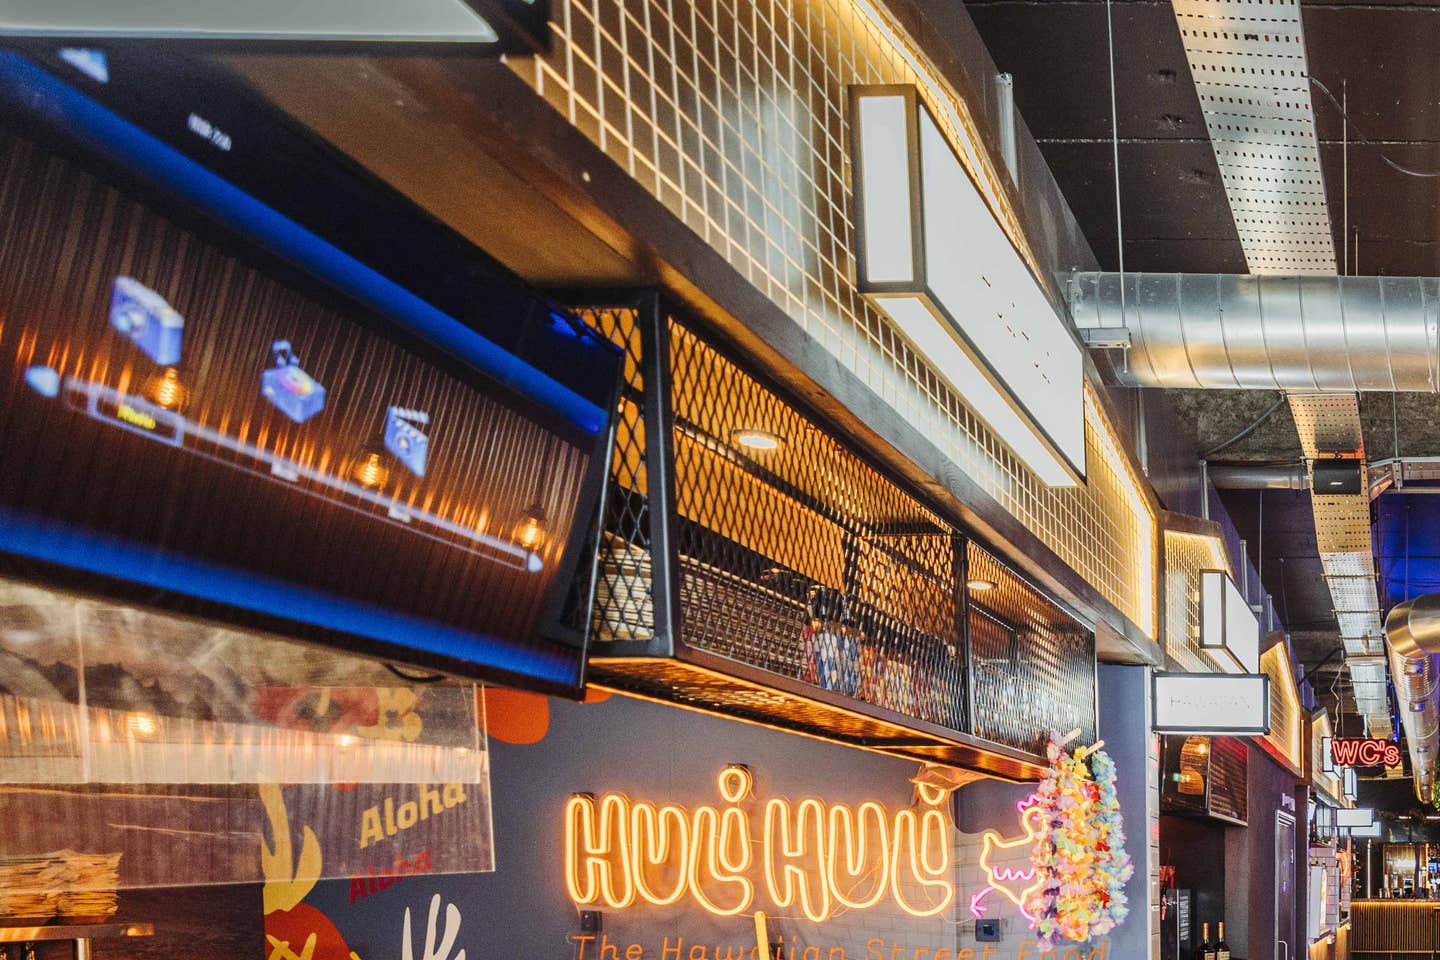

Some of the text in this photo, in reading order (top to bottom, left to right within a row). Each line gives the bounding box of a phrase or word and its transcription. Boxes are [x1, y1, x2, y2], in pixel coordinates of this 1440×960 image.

[1331, 740, 1400, 766] WC's
[359, 783, 468, 850] Aloha
[348, 850, 433, 905] Aloha
